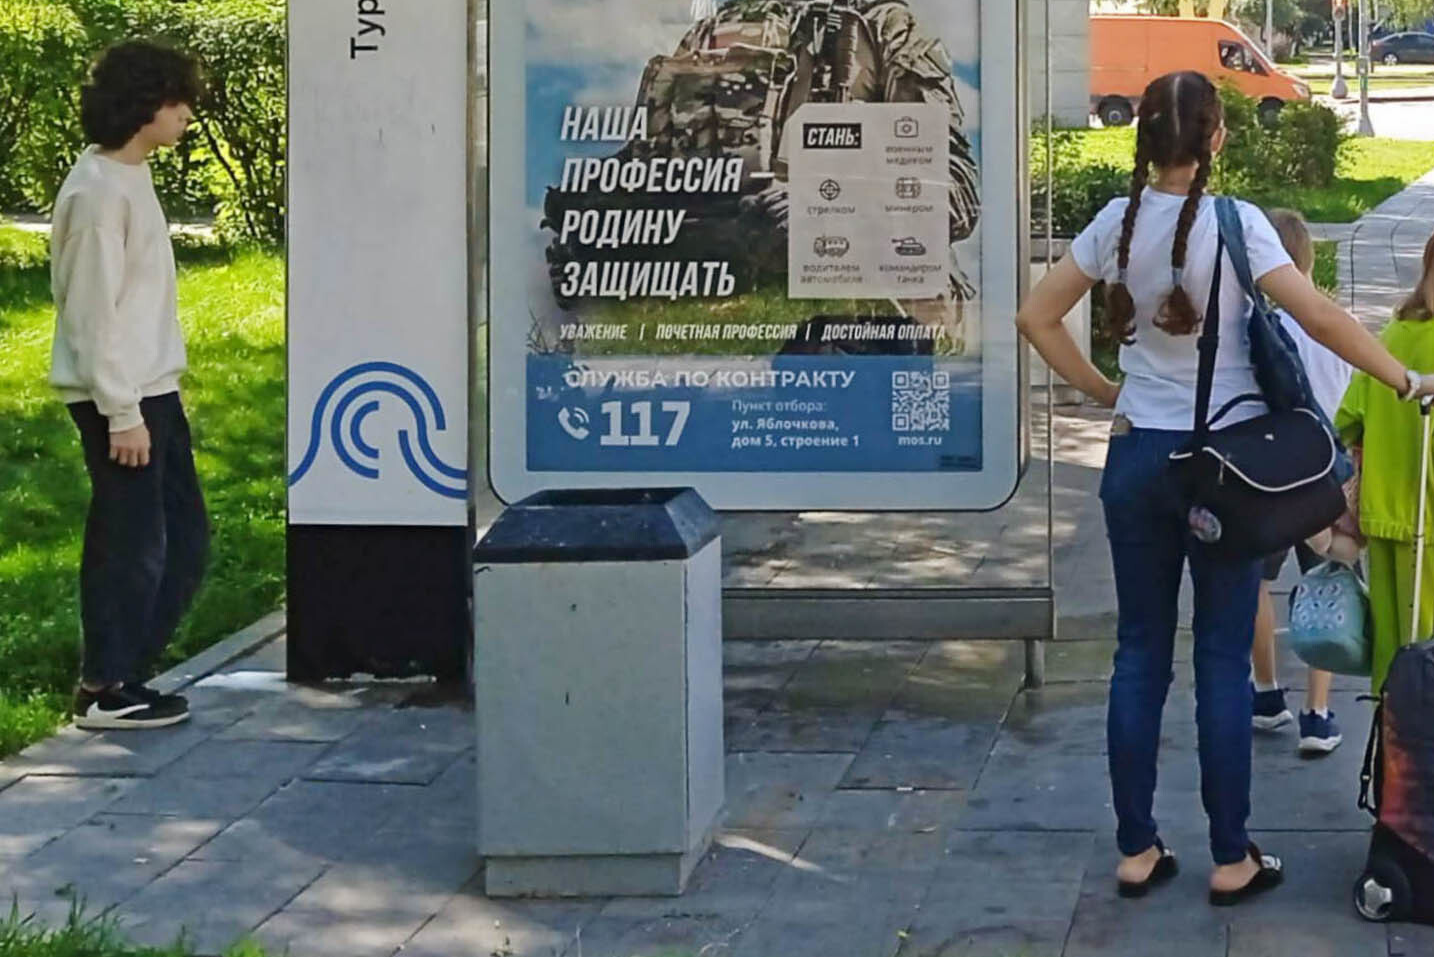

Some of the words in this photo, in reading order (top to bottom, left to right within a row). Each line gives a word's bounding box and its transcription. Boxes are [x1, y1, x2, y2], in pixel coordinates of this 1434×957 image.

[560, 106, 648, 141] НАША
[807, 127, 860, 146] СТАНЬ:
[560, 156, 744, 193] ПРОФЕССИЯ
[560, 209, 687, 249] РОДИНУ
[560, 261, 736, 301] ЗАЩИЩАТЬ
[559, 323, 629, 340] УВАЖЕНИЕ
[656, 323, 721, 340] ПОЧЕТНАЯ
[721, 323, 798, 340] ПРОФЕССИЯ
[821, 322, 898, 341] ДОСТОЙНАЯ
[897, 324, 946, 340] ОПЛАТА
[565, 370, 671, 388] СЛУЖБА
[675, 370, 709, 388] ПО
[716, 370, 856, 389] КОНТРАКТУ
[732, 399, 772, 414] Пункт
[775, 398, 828, 413] отбора:
[600, 401, 691, 446] 117
[732, 420, 754, 432] ул.
[757, 418, 840, 432] Яблочкова,
[731, 437, 762, 449] дом
[780, 437, 849, 449] строение
[853, 435, 860, 447] 1
[898, 436, 943, 446] mos.ru
